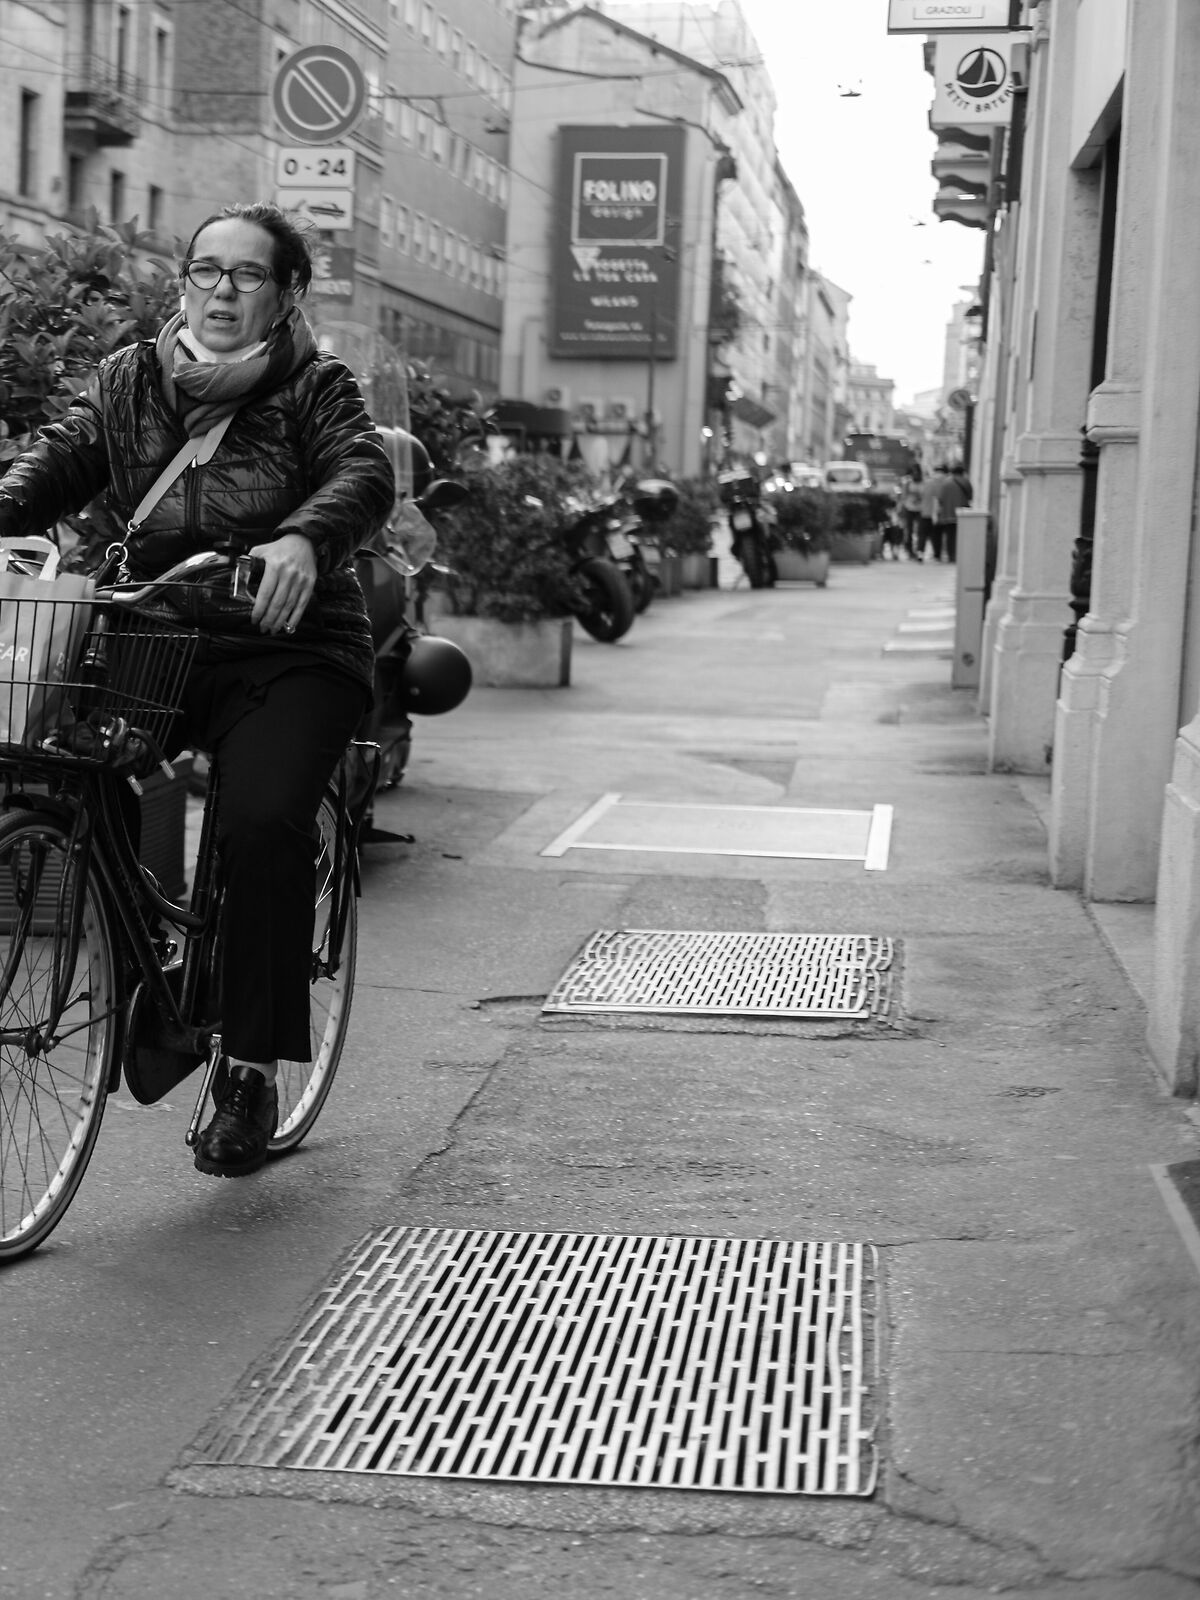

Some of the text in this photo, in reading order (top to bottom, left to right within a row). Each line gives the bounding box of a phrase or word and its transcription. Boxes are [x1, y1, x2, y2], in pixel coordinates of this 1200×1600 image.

[945, 82, 970, 110] PETIT
[317, 158, 346, 176] 24
[583, 180, 657, 201] FOLINO
